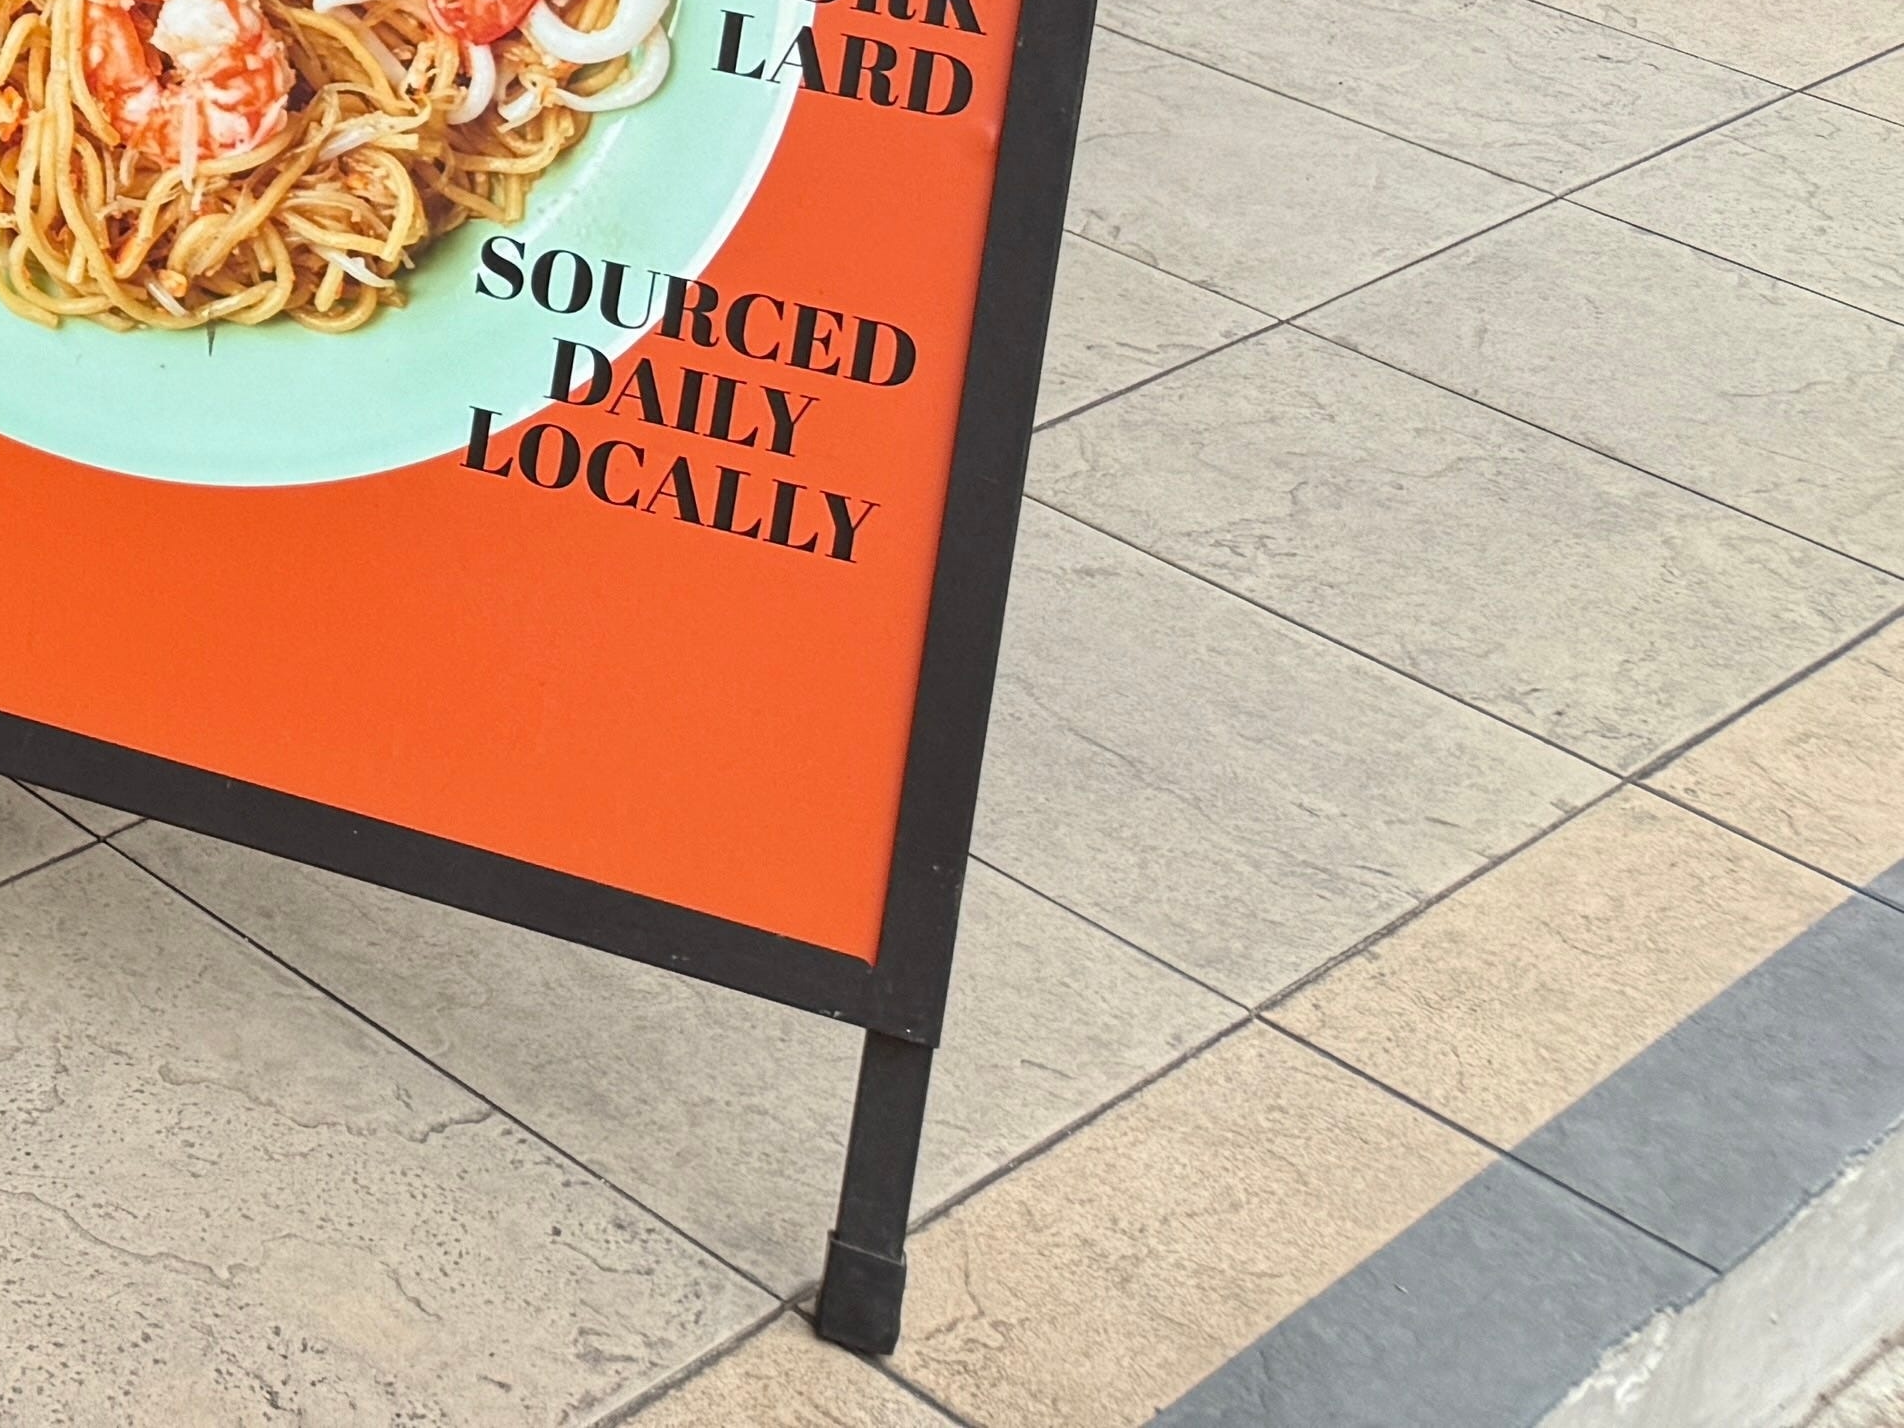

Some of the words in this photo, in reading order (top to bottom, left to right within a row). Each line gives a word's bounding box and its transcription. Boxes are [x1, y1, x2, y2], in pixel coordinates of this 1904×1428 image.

[710, 8, 974, 118] LARD
[474, 234, 918, 388] SOURCED
[543, 336, 821, 459] DAILY
[459, 405, 881, 565] LOCALLY
